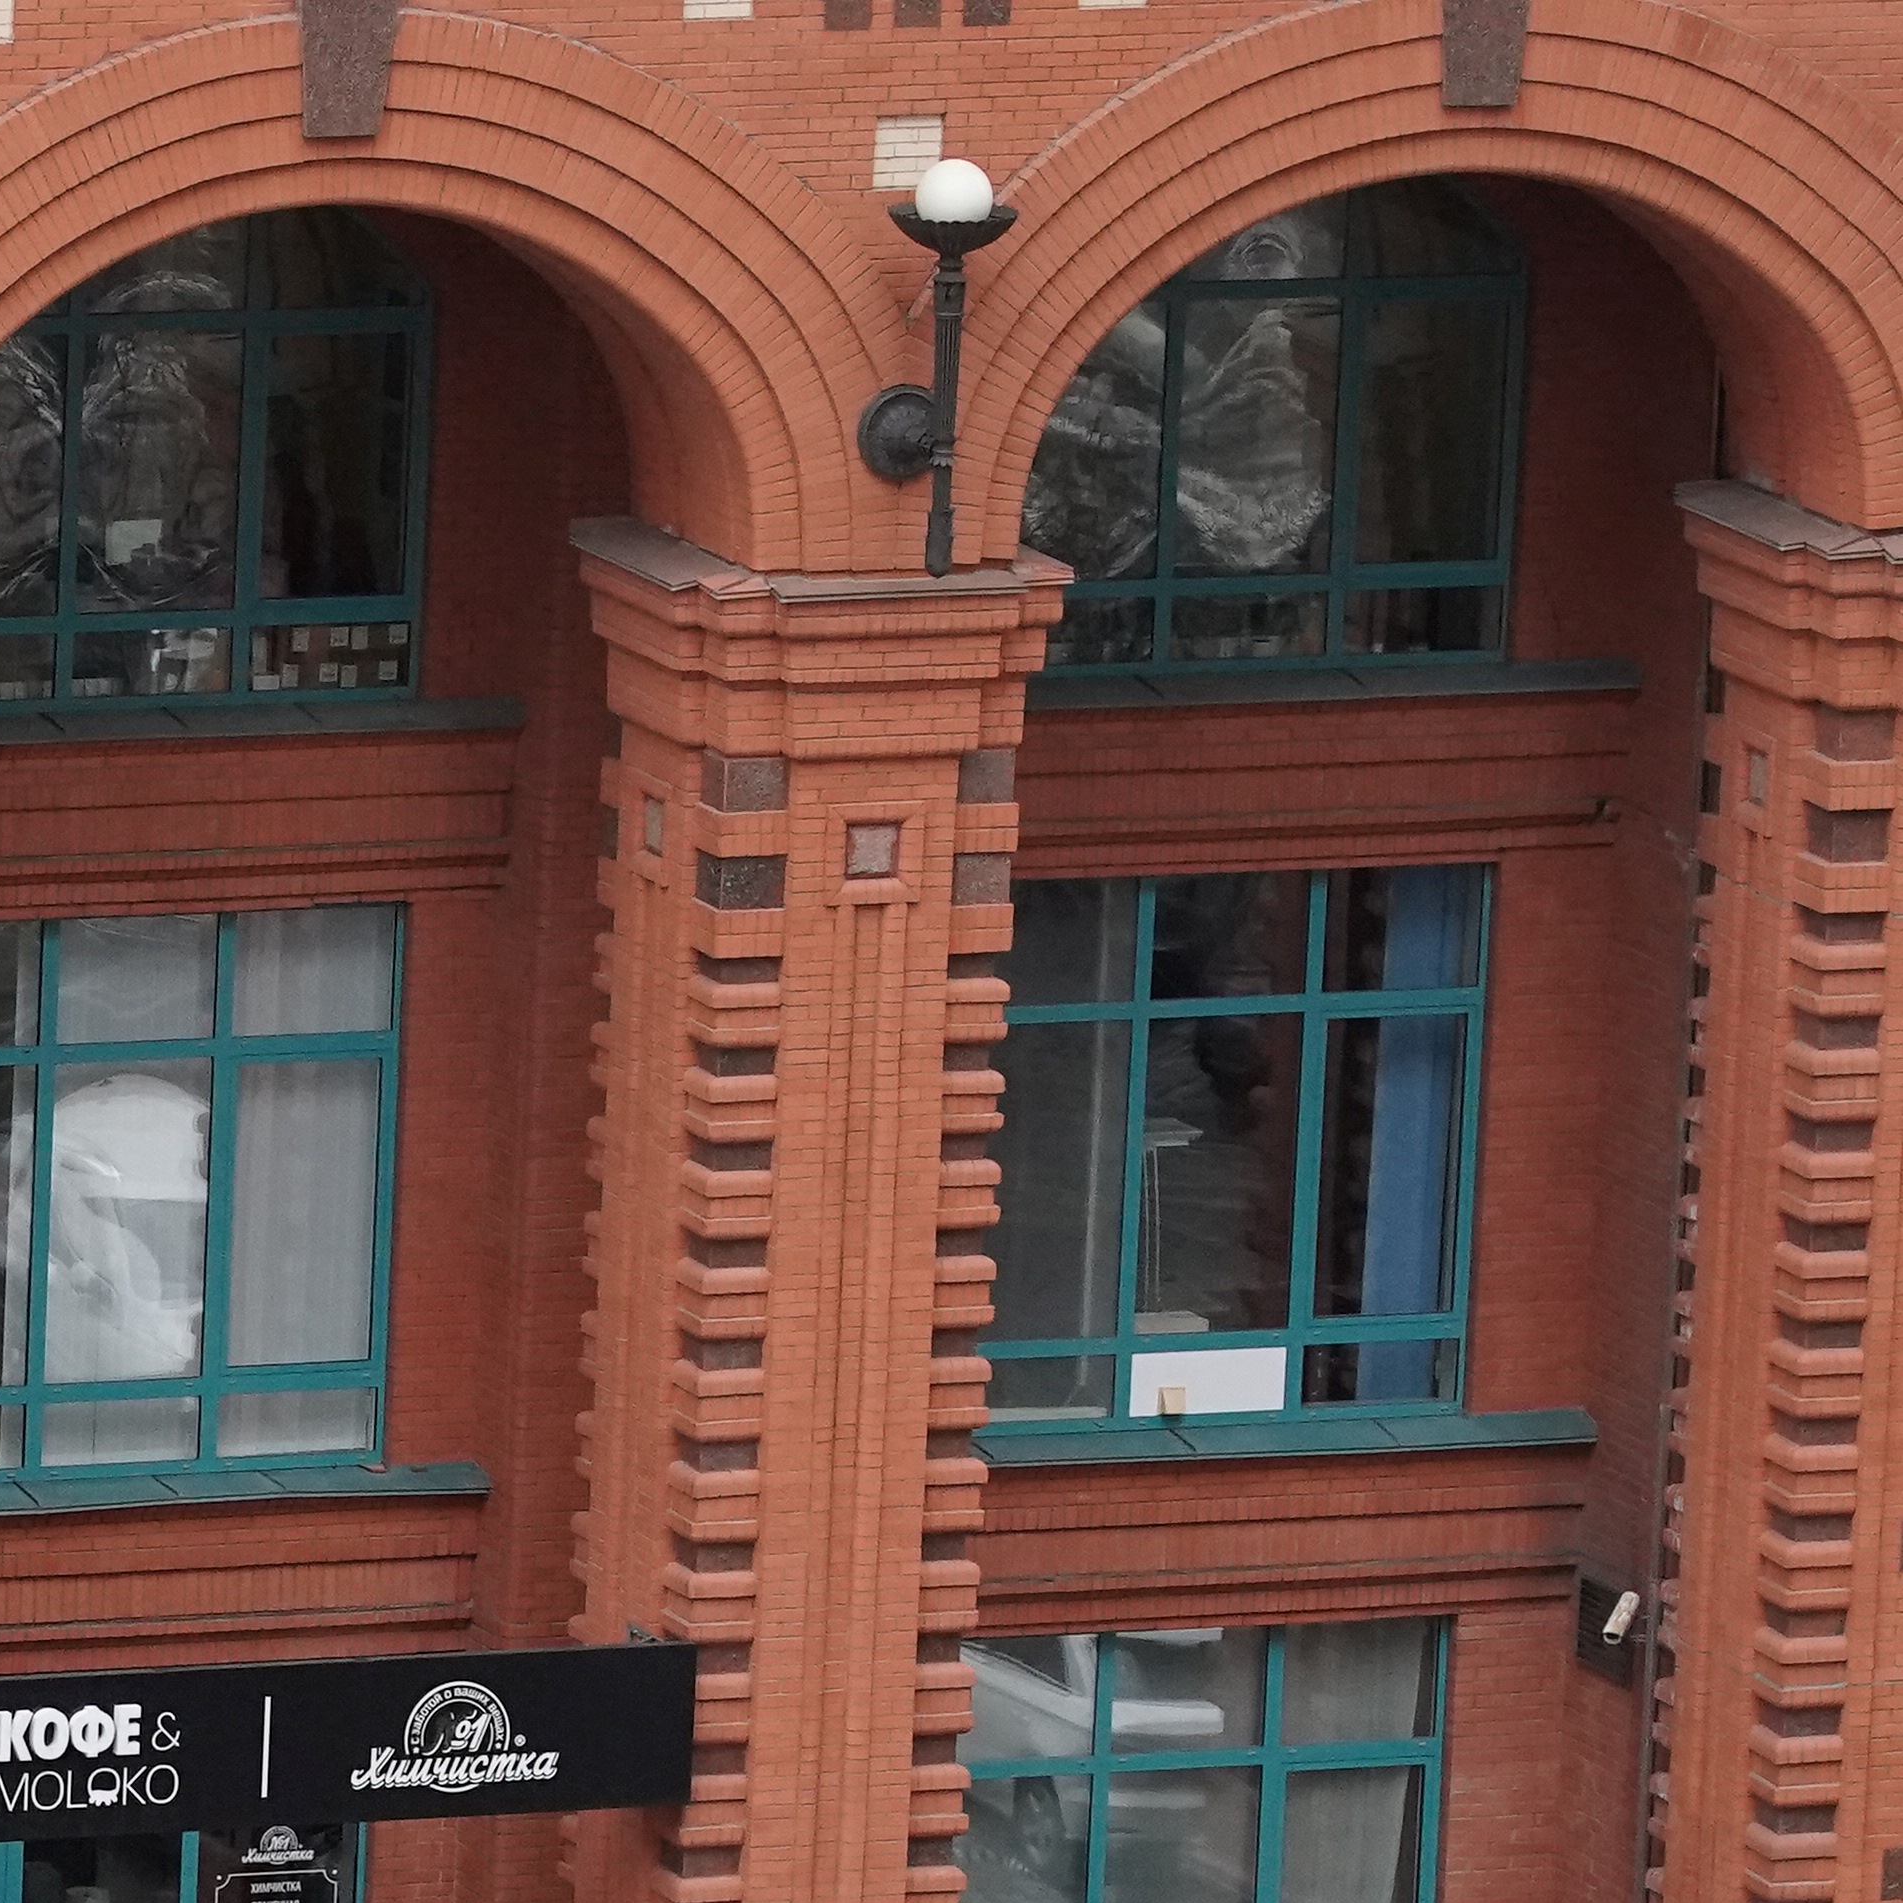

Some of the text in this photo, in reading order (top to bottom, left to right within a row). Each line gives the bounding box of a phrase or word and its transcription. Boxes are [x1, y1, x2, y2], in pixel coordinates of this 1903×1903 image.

[454, 1687, 489, 1706] ваших
[151, 1711, 181, 1752] &
[350, 1746, 560, 1791] Химчистка
[241, 1848, 315, 1864] Химчистка
[250, 1881, 302, 1894] ХИМЧИСТКА
